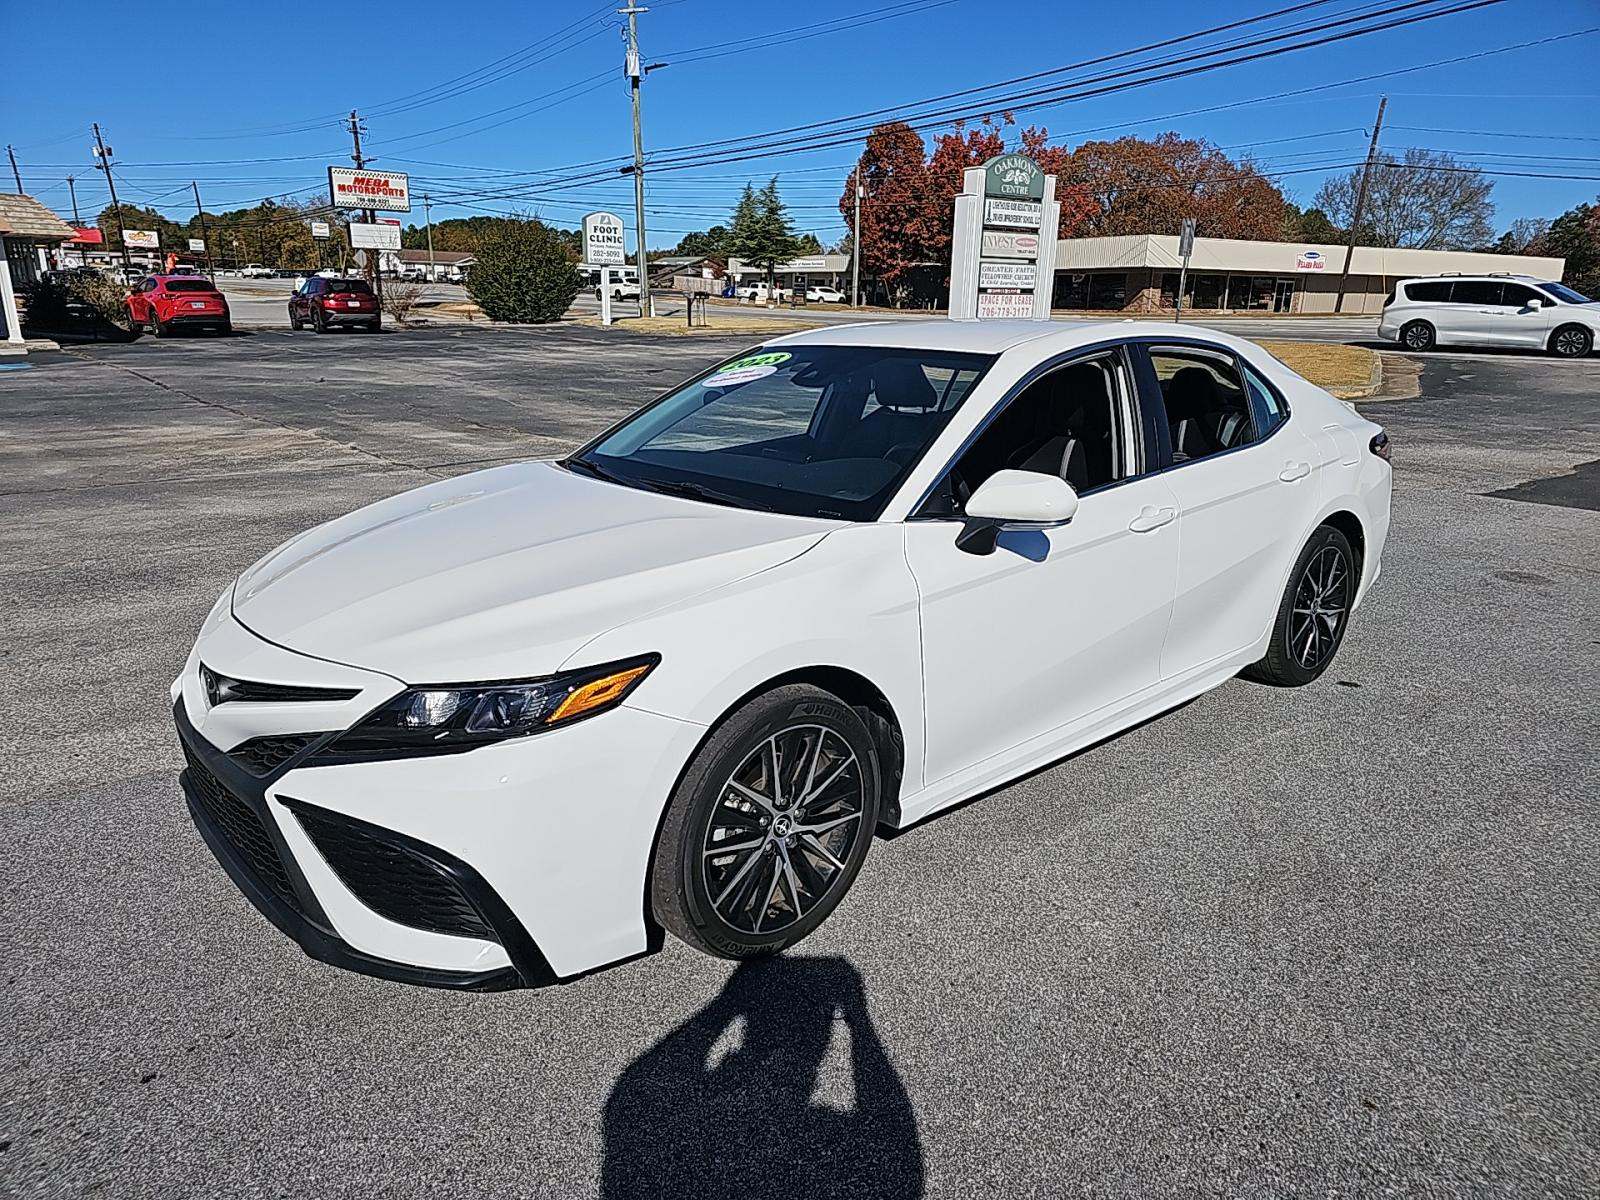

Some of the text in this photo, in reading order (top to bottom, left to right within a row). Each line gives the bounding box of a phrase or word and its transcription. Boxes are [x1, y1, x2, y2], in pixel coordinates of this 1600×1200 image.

[994, 158, 1037, 178] OAKMONT
[337, 184, 405, 197] MOTORSPORTS
[1001, 184, 1029, 195] CENTRE
[593, 226, 618, 234] FOOT
[590, 235, 622, 243] CLINIC
[982, 265, 1035, 274] GREATER FAITH
[980, 296, 1033, 305] SPACE FOR LEASE
